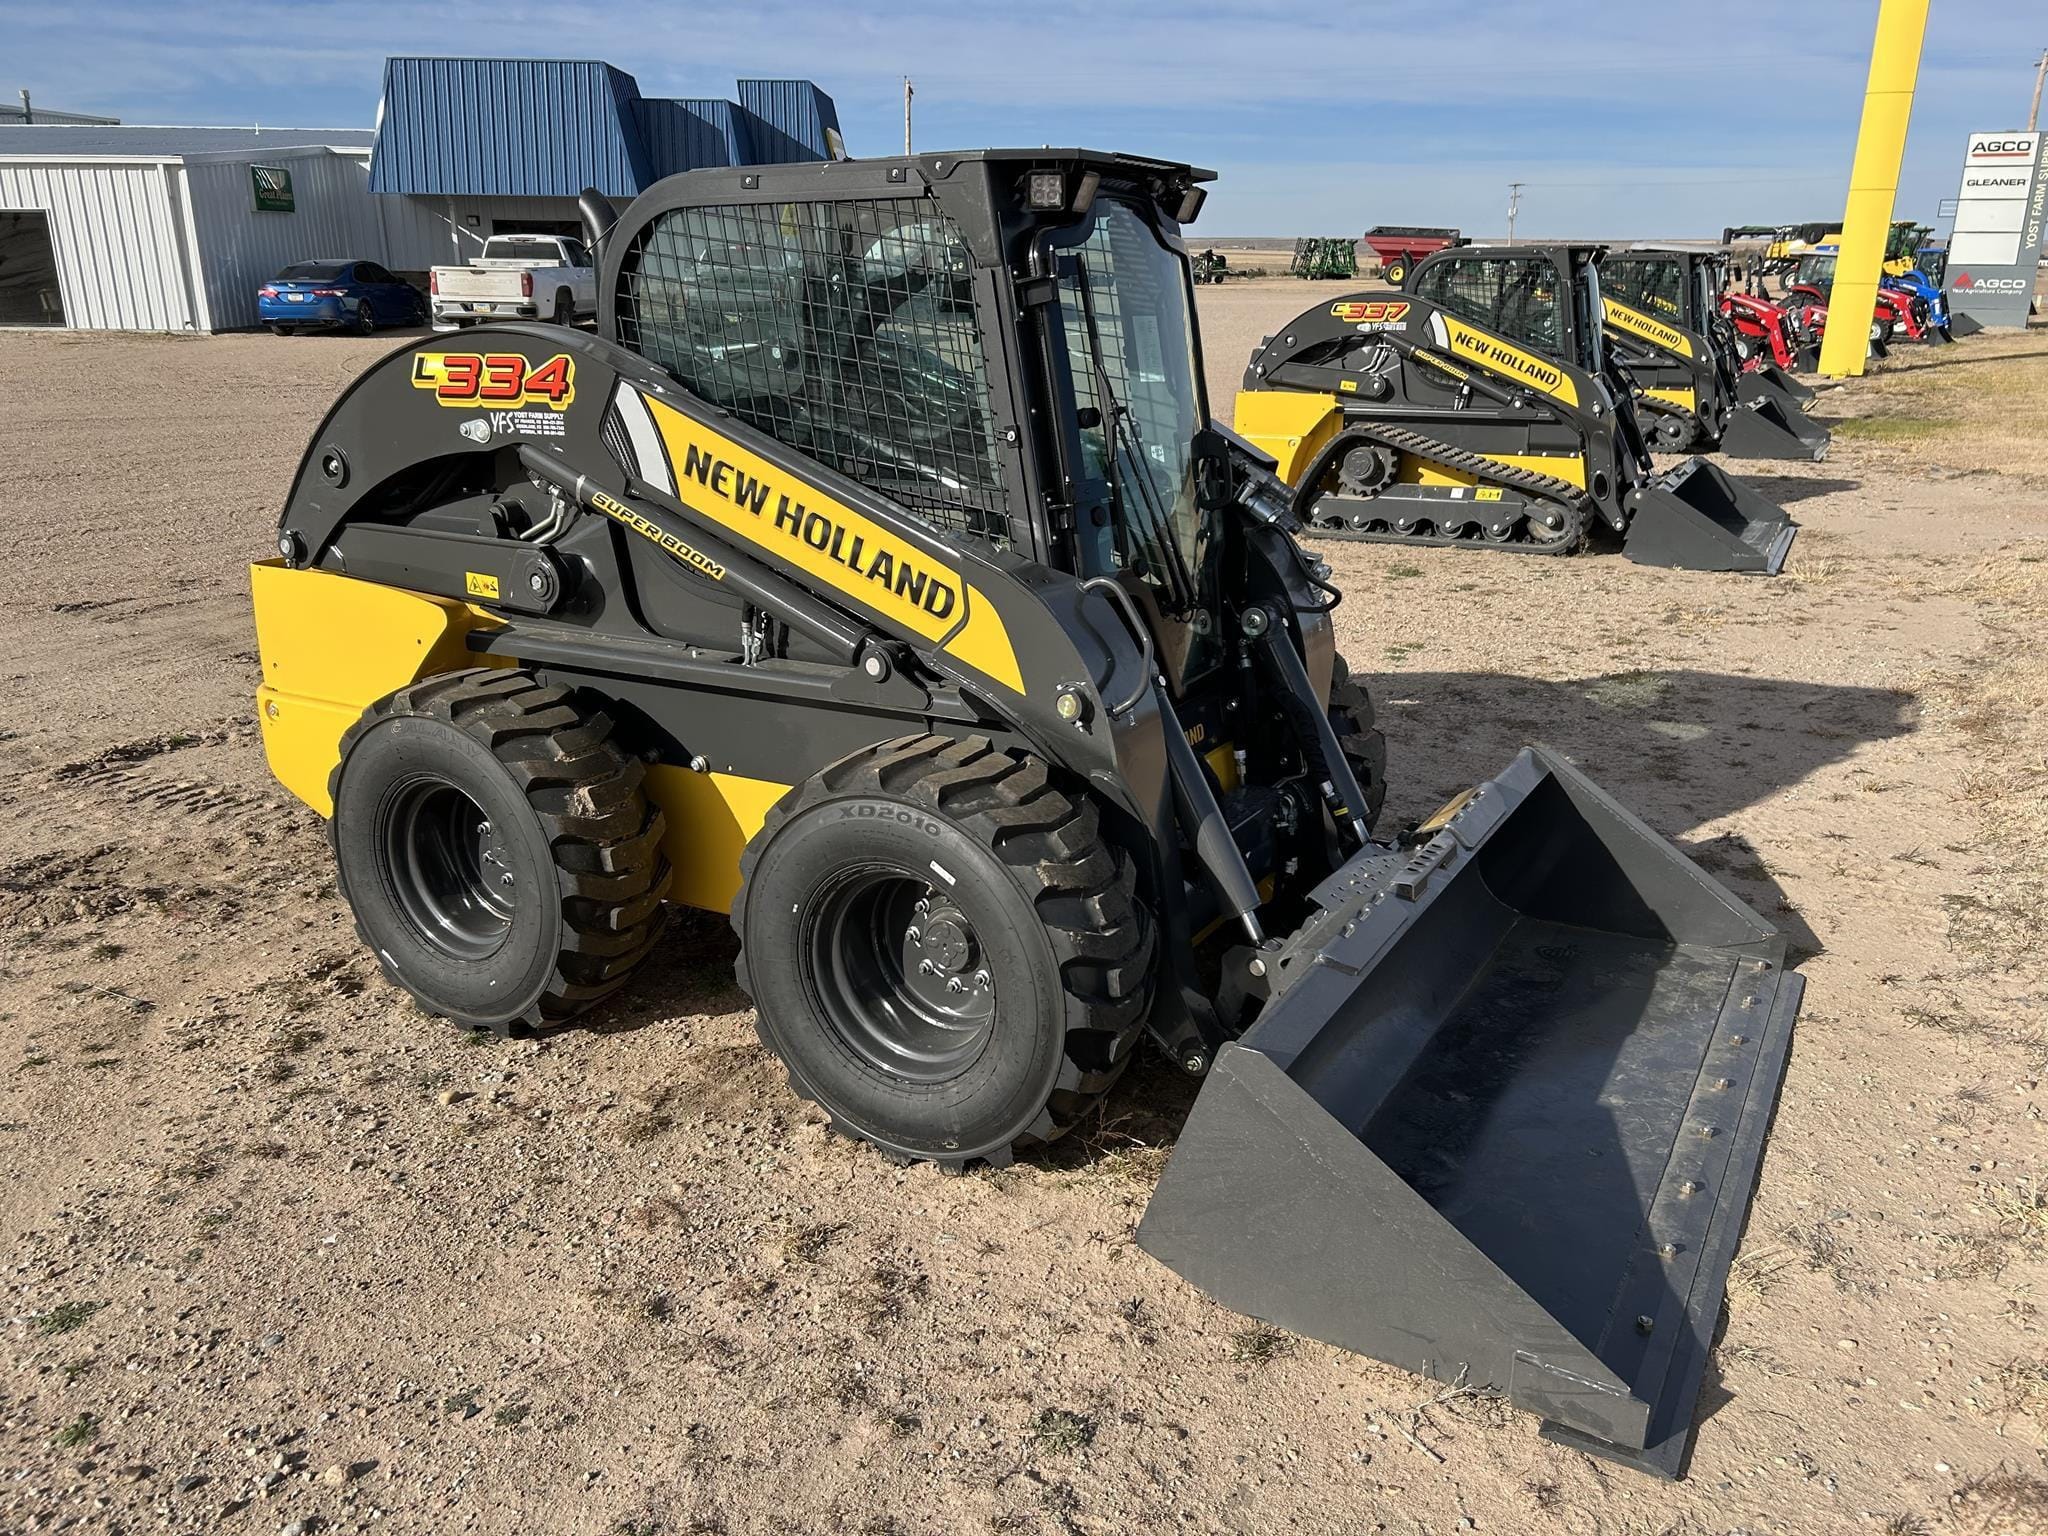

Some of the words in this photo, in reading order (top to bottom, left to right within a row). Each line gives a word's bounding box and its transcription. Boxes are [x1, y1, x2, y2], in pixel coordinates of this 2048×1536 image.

[1972, 141, 2031, 153] AGCO
[1967, 179, 2026, 187] GLEANER
[2025, 221, 2039, 250] YOST
[2032, 184, 2047, 216] FARM
[1974, 278, 2026, 289] AGCO
[1610, 308, 1633, 324] NEW
[1634, 320, 1679, 344] HOLLAND
[1454, 330, 1489, 356] NEW
[1489, 347, 1558, 386] HOLLAND
[490, 411, 515, 434] YFS
[592, 492, 662, 543] SUPER
[660, 533, 726, 581] BOOM
[683, 442, 771, 516] NEW
[774, 493, 956, 620] HOLLAND
[839, 804, 941, 837] XD2010
